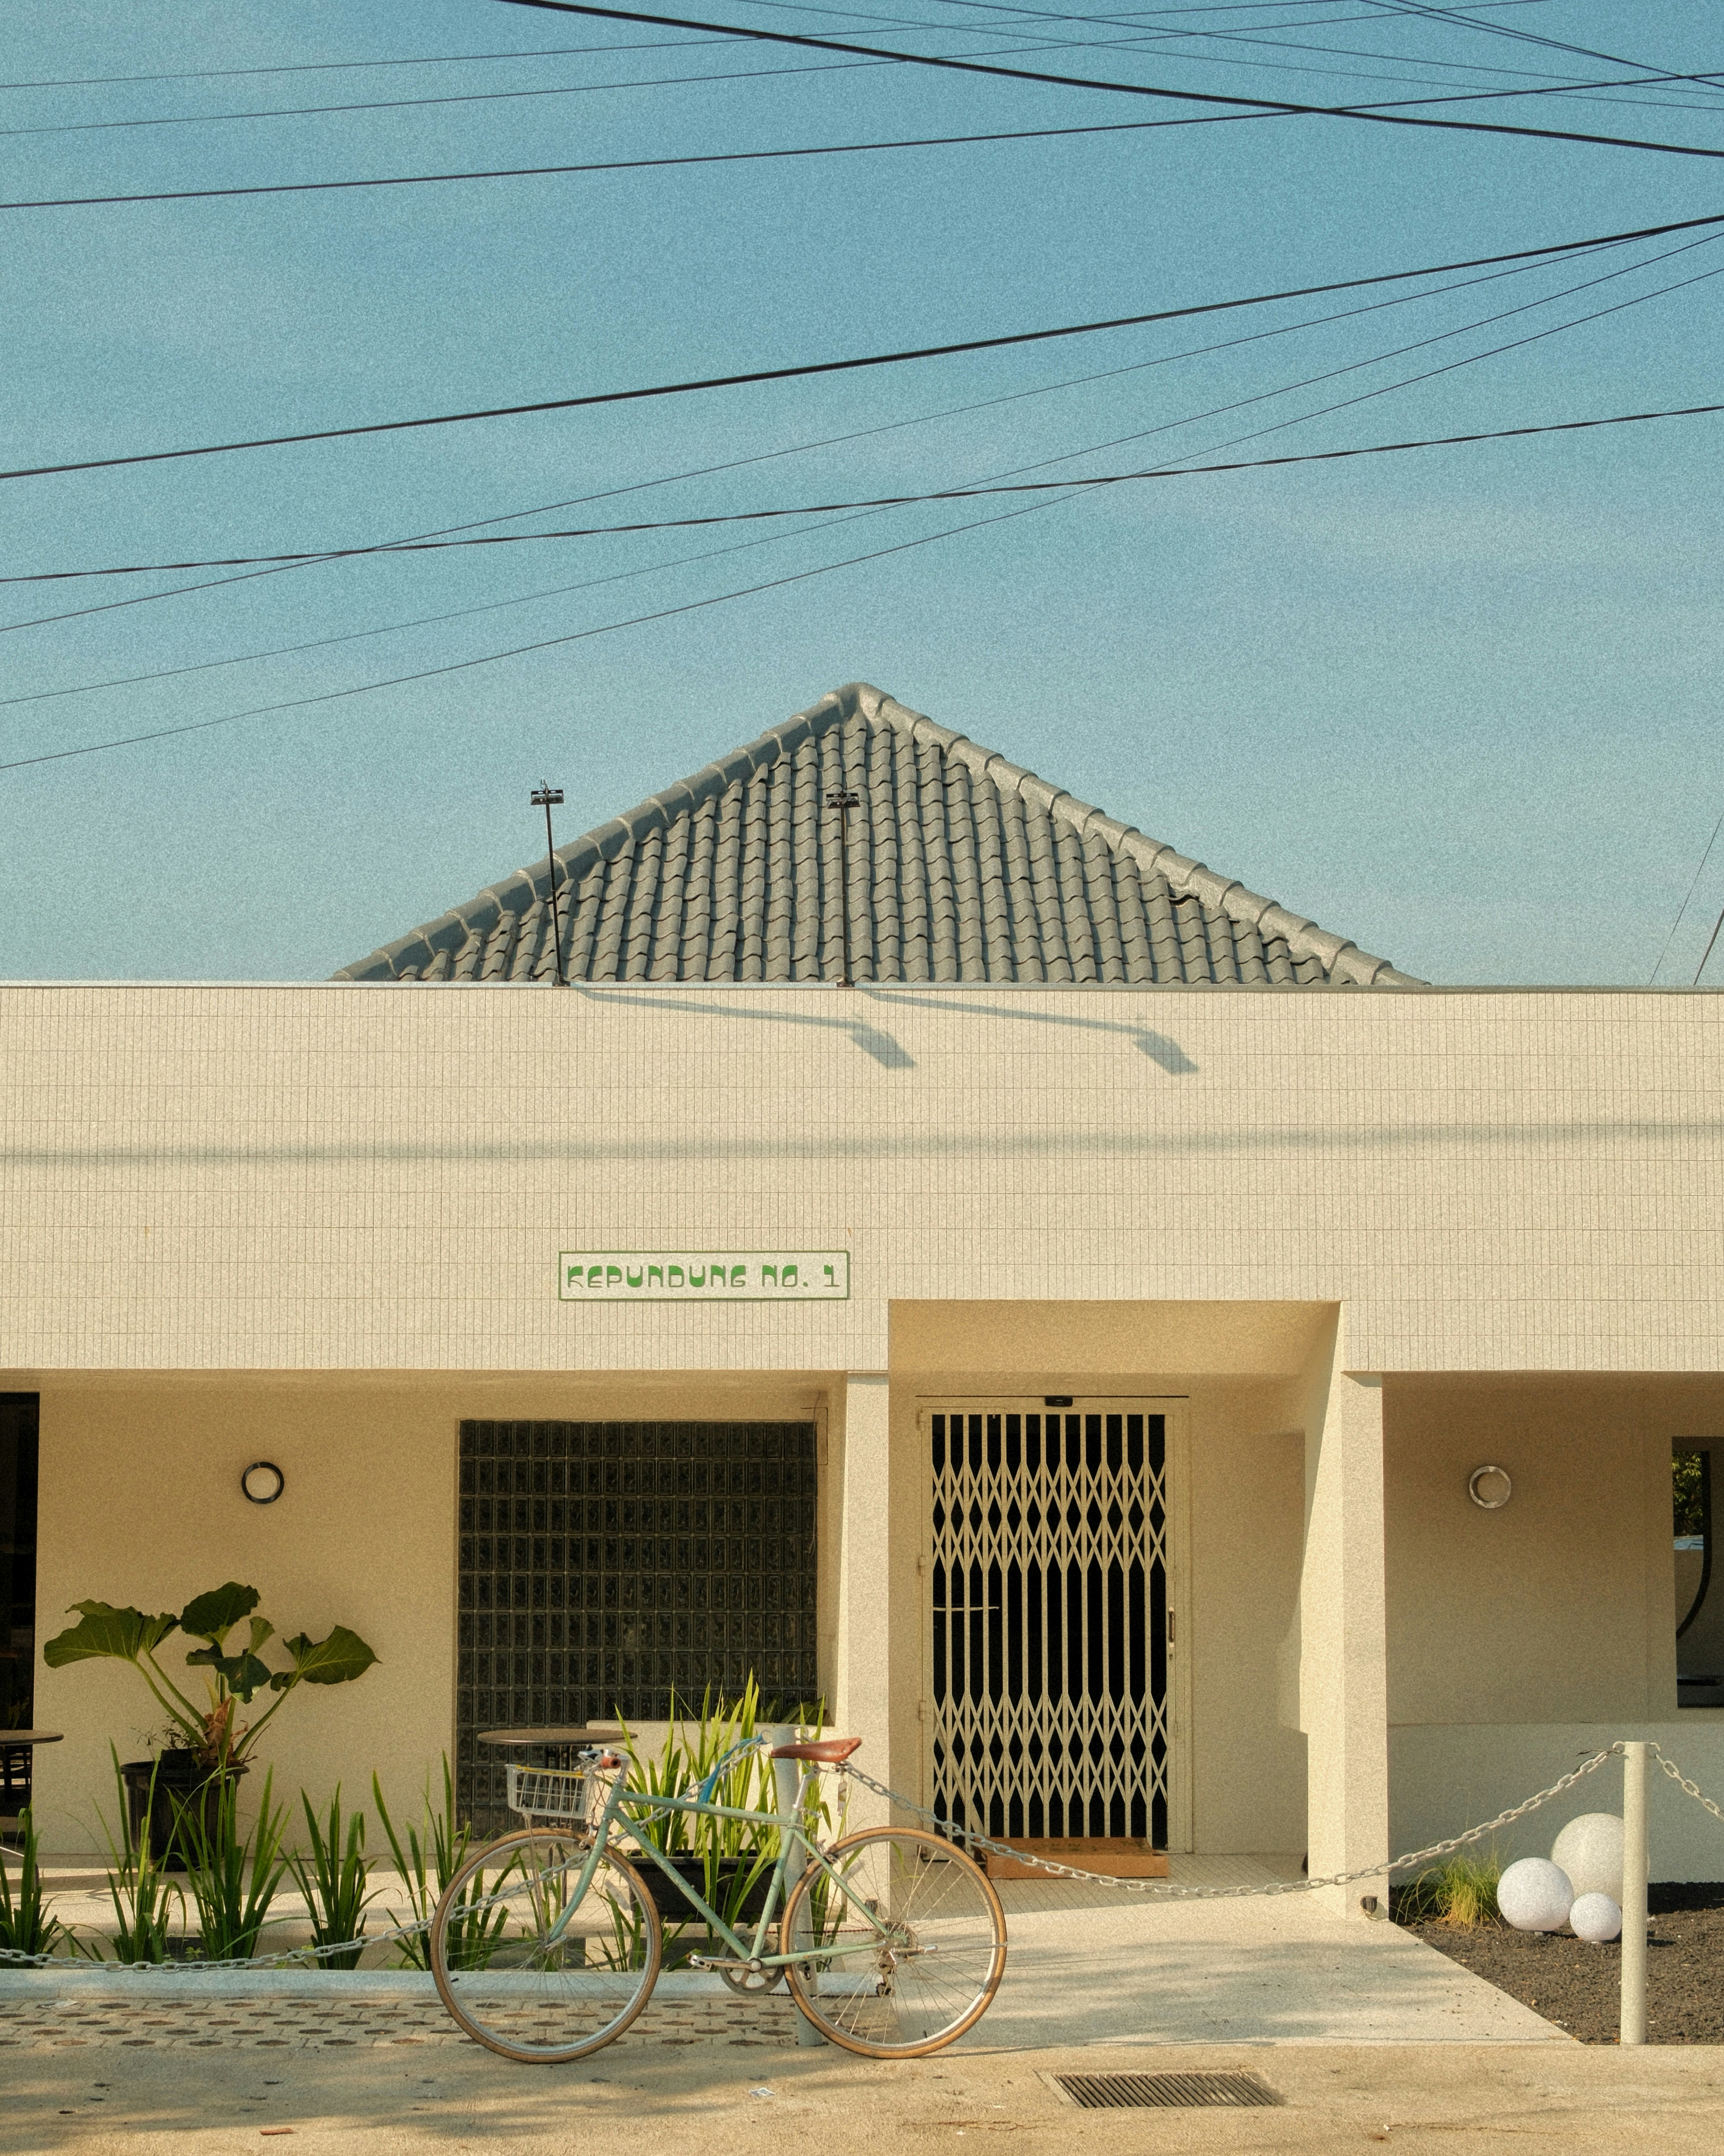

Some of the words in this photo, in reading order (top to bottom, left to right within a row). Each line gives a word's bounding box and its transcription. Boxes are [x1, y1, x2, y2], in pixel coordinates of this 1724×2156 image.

[568, 1265, 746, 1288] KEPUNDUNG
[762, 1265, 808, 1287] NO.
[824, 1265, 840, 1287] 1
